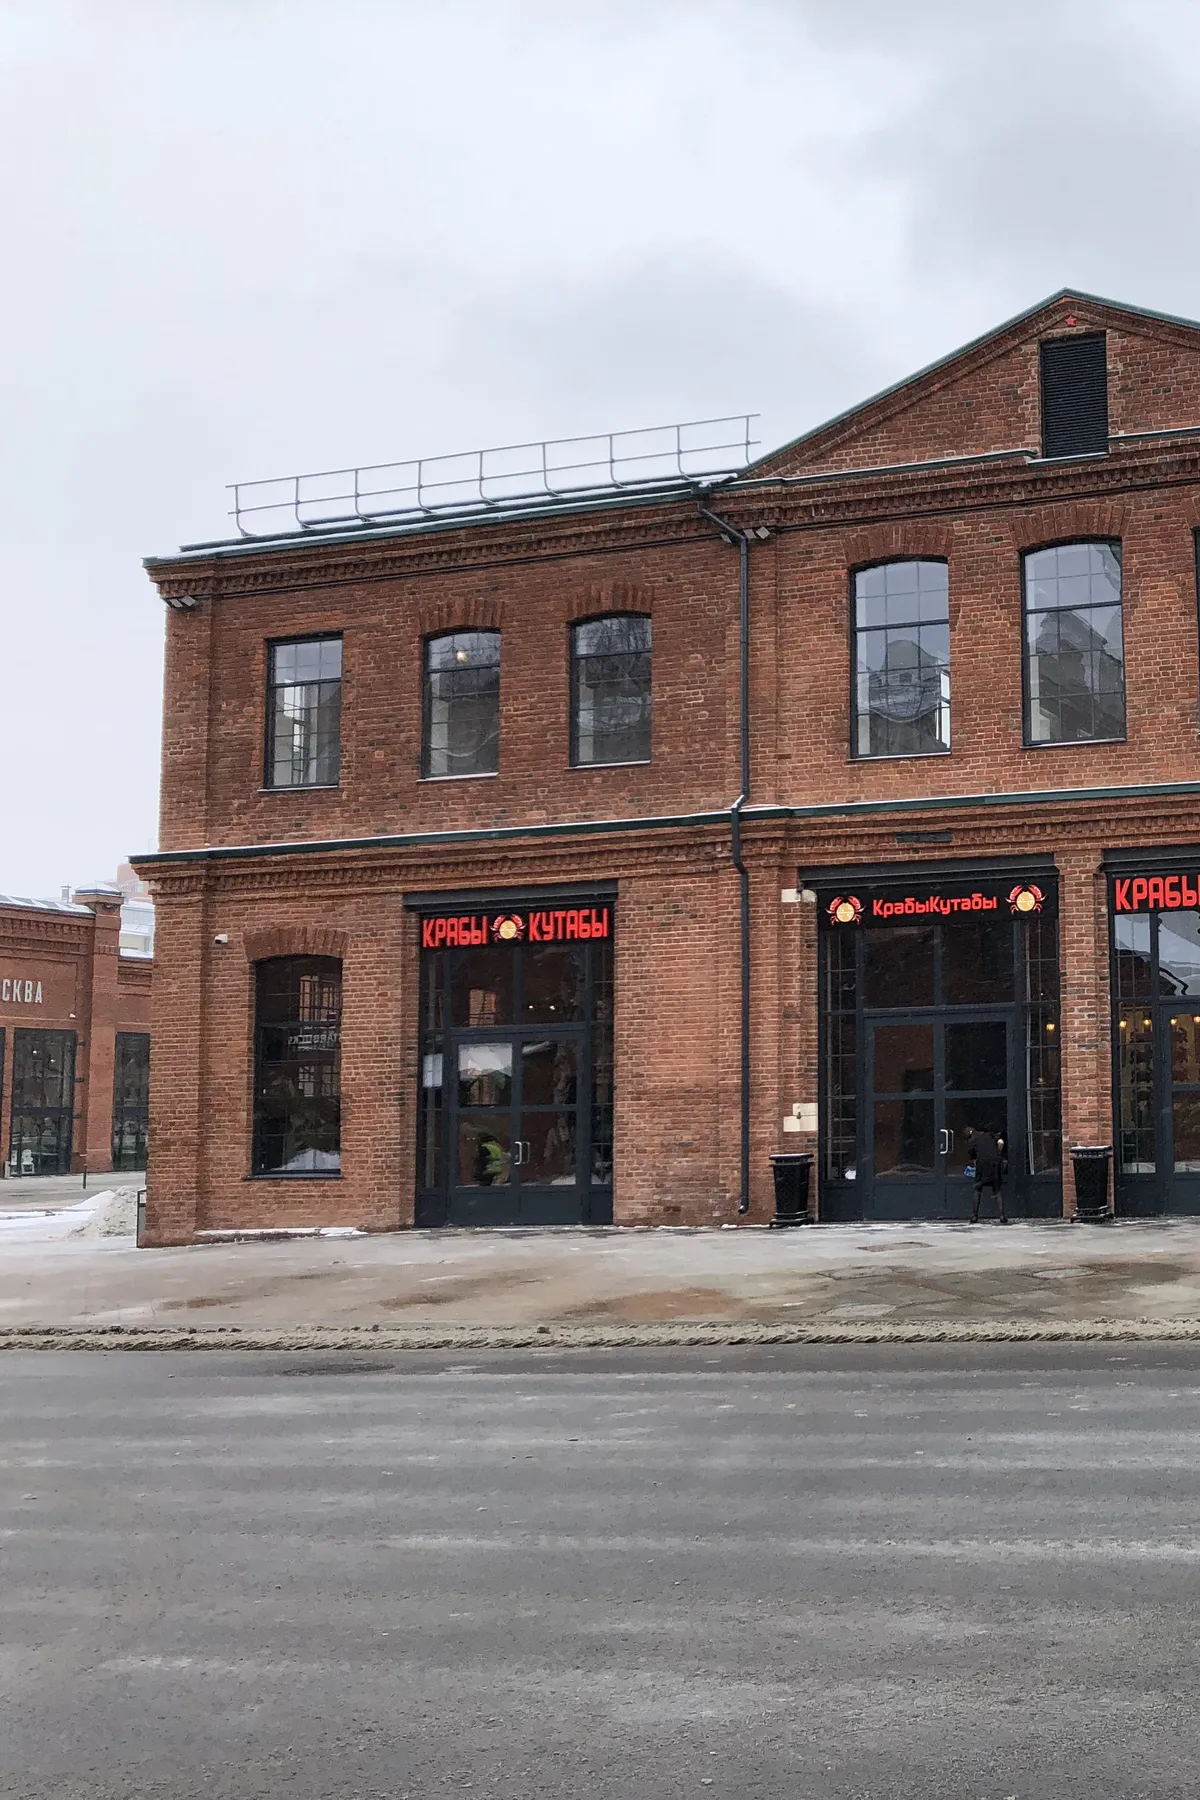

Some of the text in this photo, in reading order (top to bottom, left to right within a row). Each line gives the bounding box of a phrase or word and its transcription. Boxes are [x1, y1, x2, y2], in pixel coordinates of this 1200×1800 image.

[872, 892, 998, 918] КрабыКутабы
[422, 907, 609, 948] КРАБЫ КУТАБЫ
[2, 978, 43, 1004] СКВА
